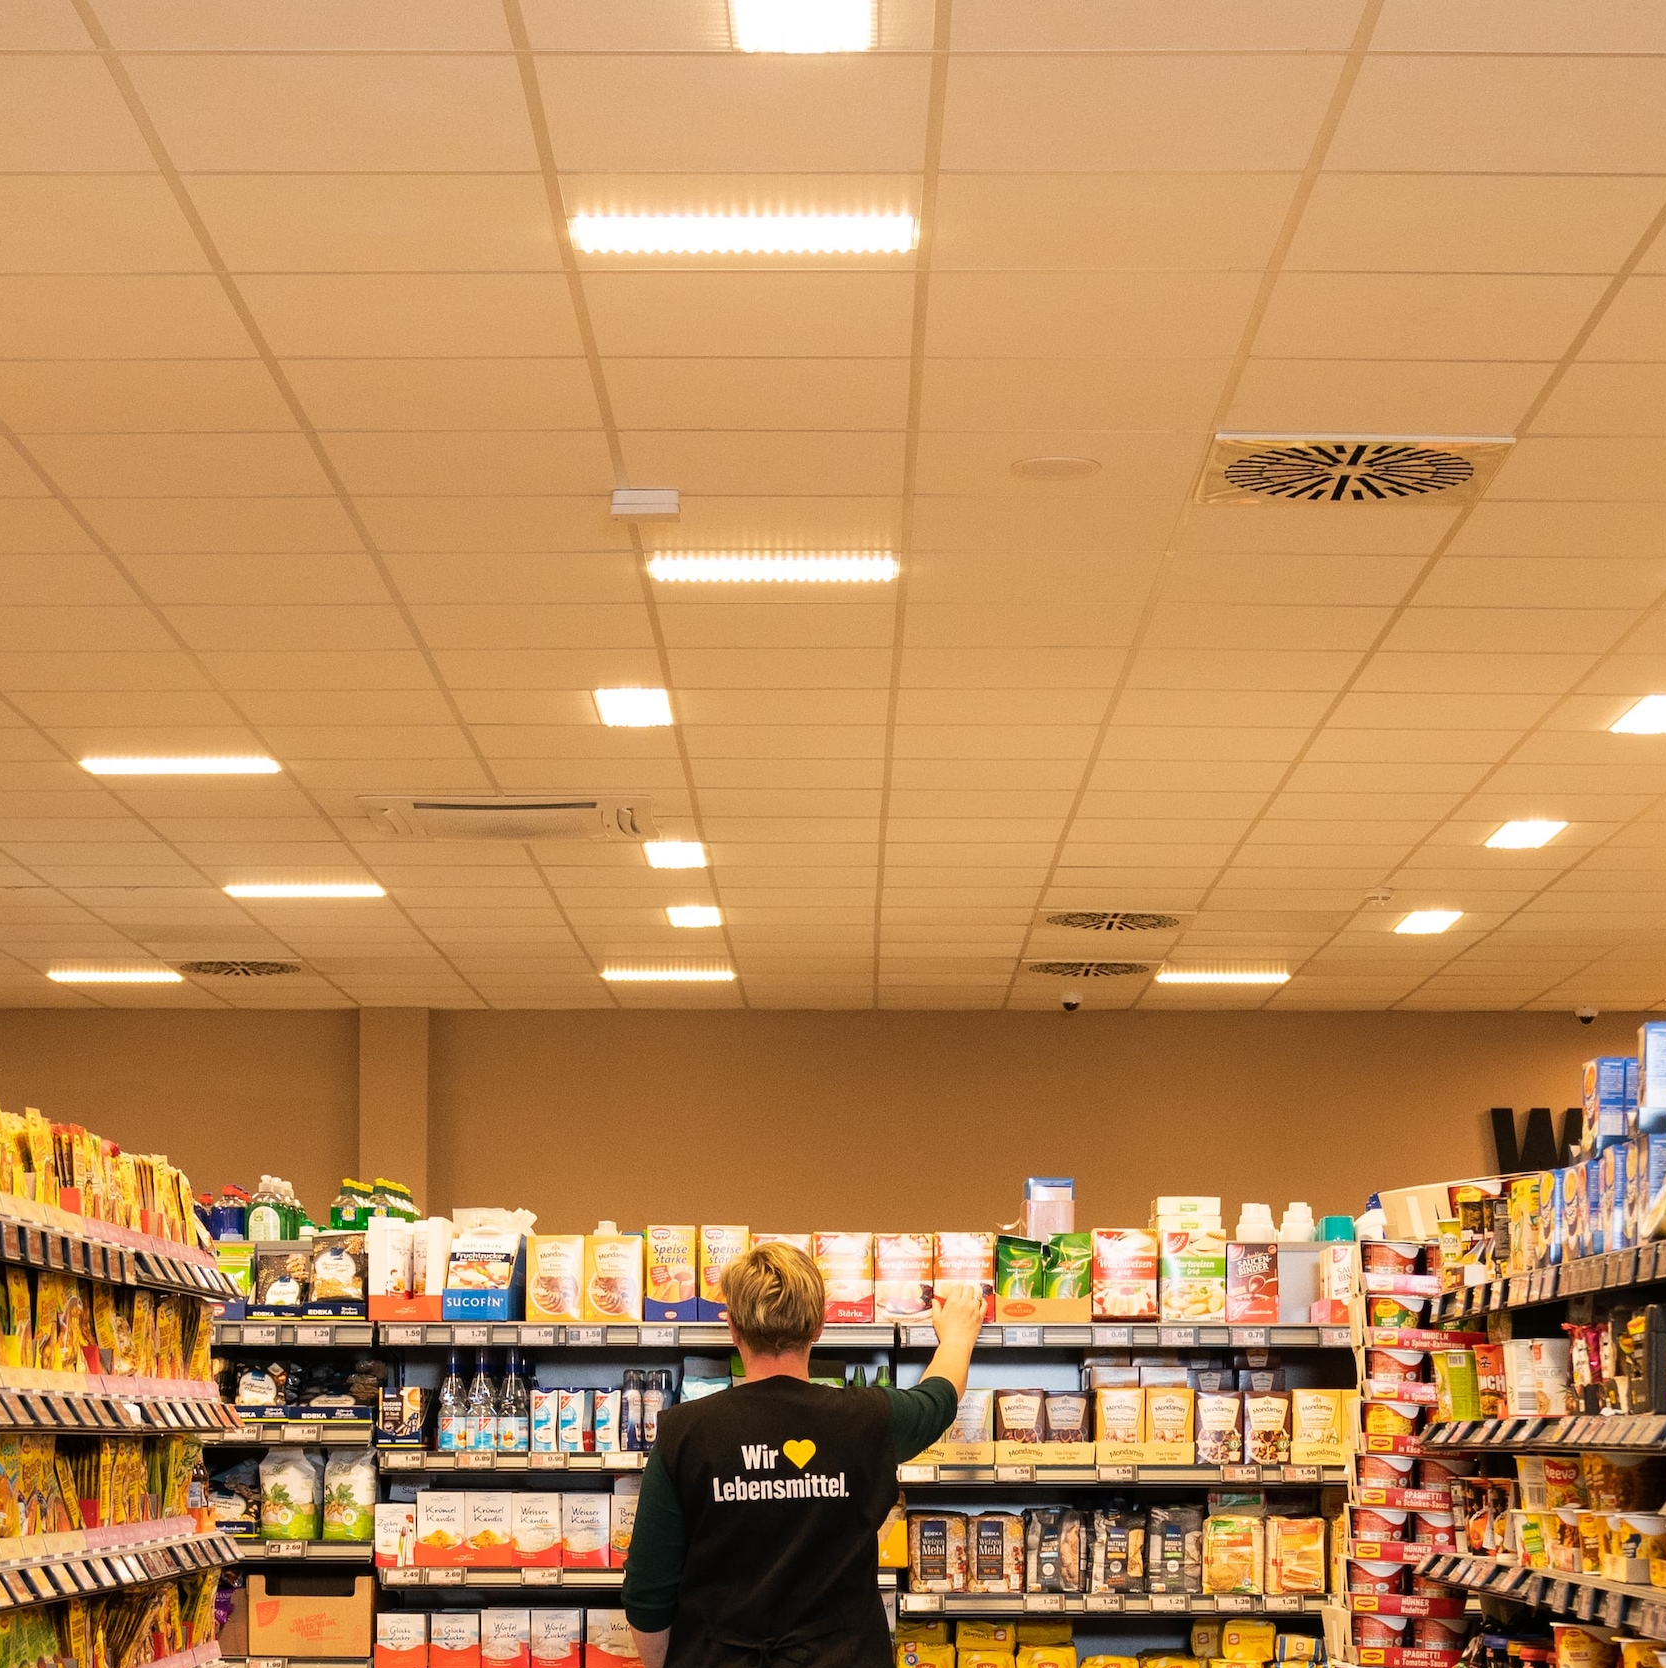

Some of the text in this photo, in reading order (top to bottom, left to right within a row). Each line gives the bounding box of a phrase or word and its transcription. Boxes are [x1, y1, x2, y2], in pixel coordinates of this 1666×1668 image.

[656, 1255, 687, 1264] stärke
[879, 1260, 930, 1270] Kartoffelstärke
[939, 1260, 990, 1270] Kartoffelstärke
[838, 1309, 863, 1317] Stärke
[1155, 1405, 1185, 1413] Mondamin
[741, 1445, 778, 1470] Wir
[1008, 1448, 1043, 1458] Mondamin
[1545, 1465, 1576, 1479] Reeva
[713, 1473, 849, 1502] Lebensmittel.
[1404, 1491, 1442, 1500] SPAGHETTI
[1403, 1499, 1449, 1509] Schinken-Sauce
[521, 1507, 549, 1516] Weisser
[572, 1508, 600, 1516] Weisser
[427, 1514, 455, 1522] Kandis
[474, 1514, 503, 1522] Kandis
[520, 1516, 549, 1524] Kandis
[571, 1516, 600, 1524] Kandis
[922, 1546, 945, 1555] Mehl
[979, 1546, 1002, 1555] Mehl
[1404, 1545, 1431, 1553] HÜHNER
[1402, 1596, 1429, 1606] HÜHNER
[1401, 1606, 1429, 1616] Nudeltopf
[494, 1623, 517, 1631] Würfel
[544, 1623, 567, 1631] Würfel
[494, 1631, 517, 1639] Zucker
[544, 1631, 567, 1640] Zucker
[1403, 1650, 1440, 1659] SPAGHETTI
[1402, 1658, 1447, 1667] Tomaten-Sauce
